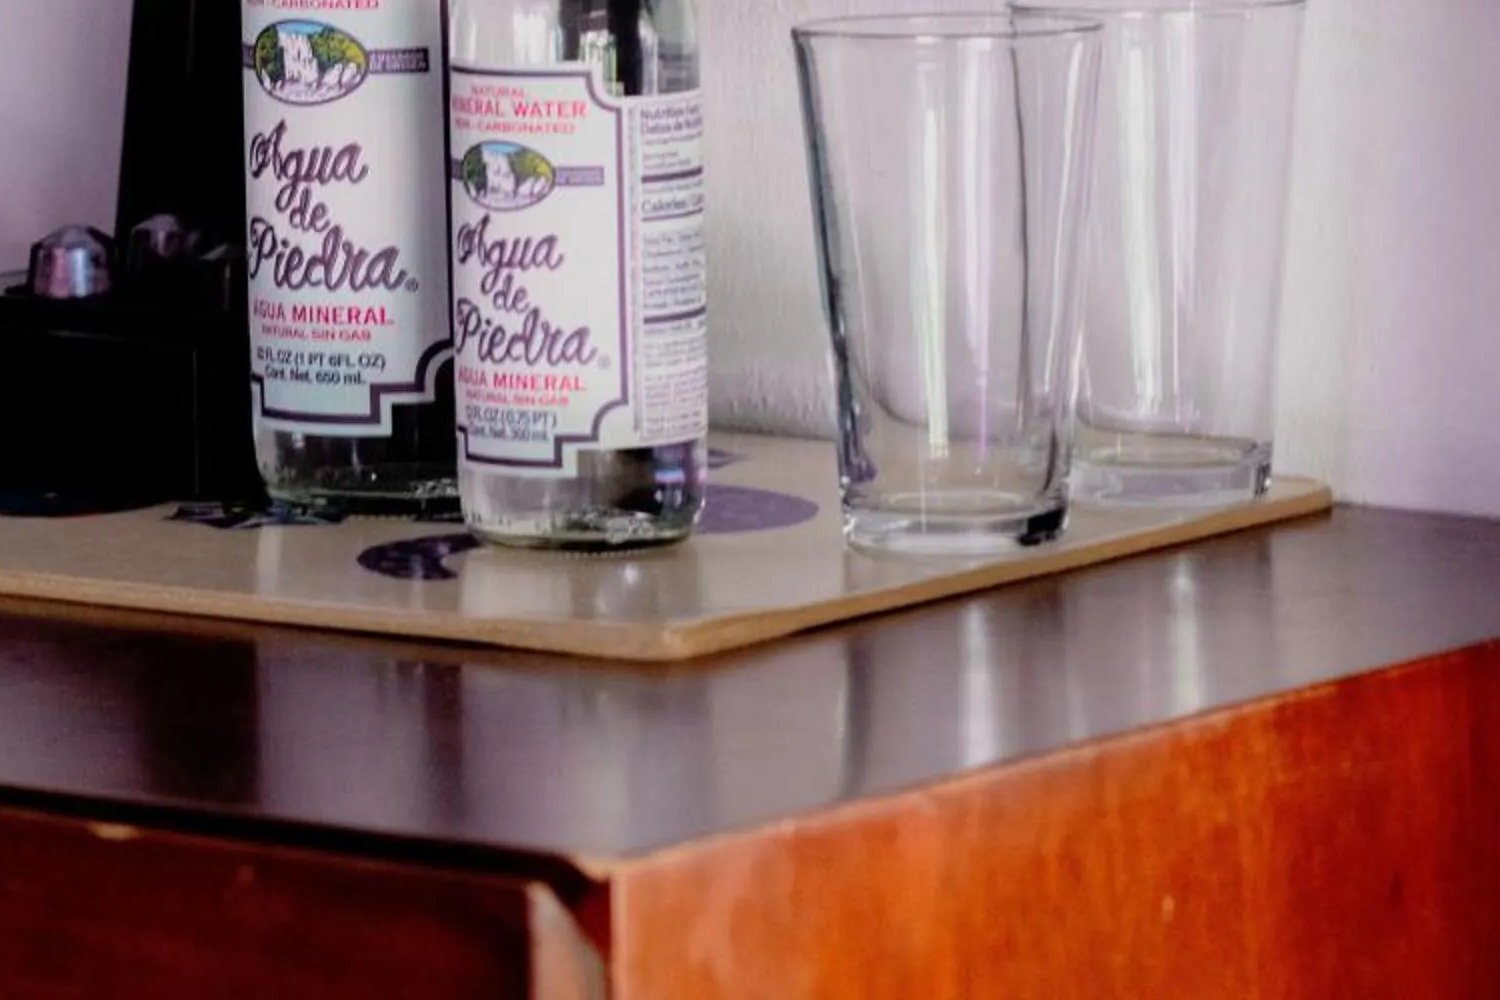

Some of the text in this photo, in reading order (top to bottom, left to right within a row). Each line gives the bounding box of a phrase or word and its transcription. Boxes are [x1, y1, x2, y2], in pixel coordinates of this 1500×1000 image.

[513, 100, 587, 118] WATER
[250, 118, 370, 213] Agua
[289, 187, 331, 234] de
[249, 216, 408, 293] Piedra
[457, 213, 564, 295] Agua
[292, 304, 395, 326] MINERAL
[493, 274, 531, 313] de
[454, 298, 597, 366] Piedra
[493, 373, 587, 392] MINERAL
